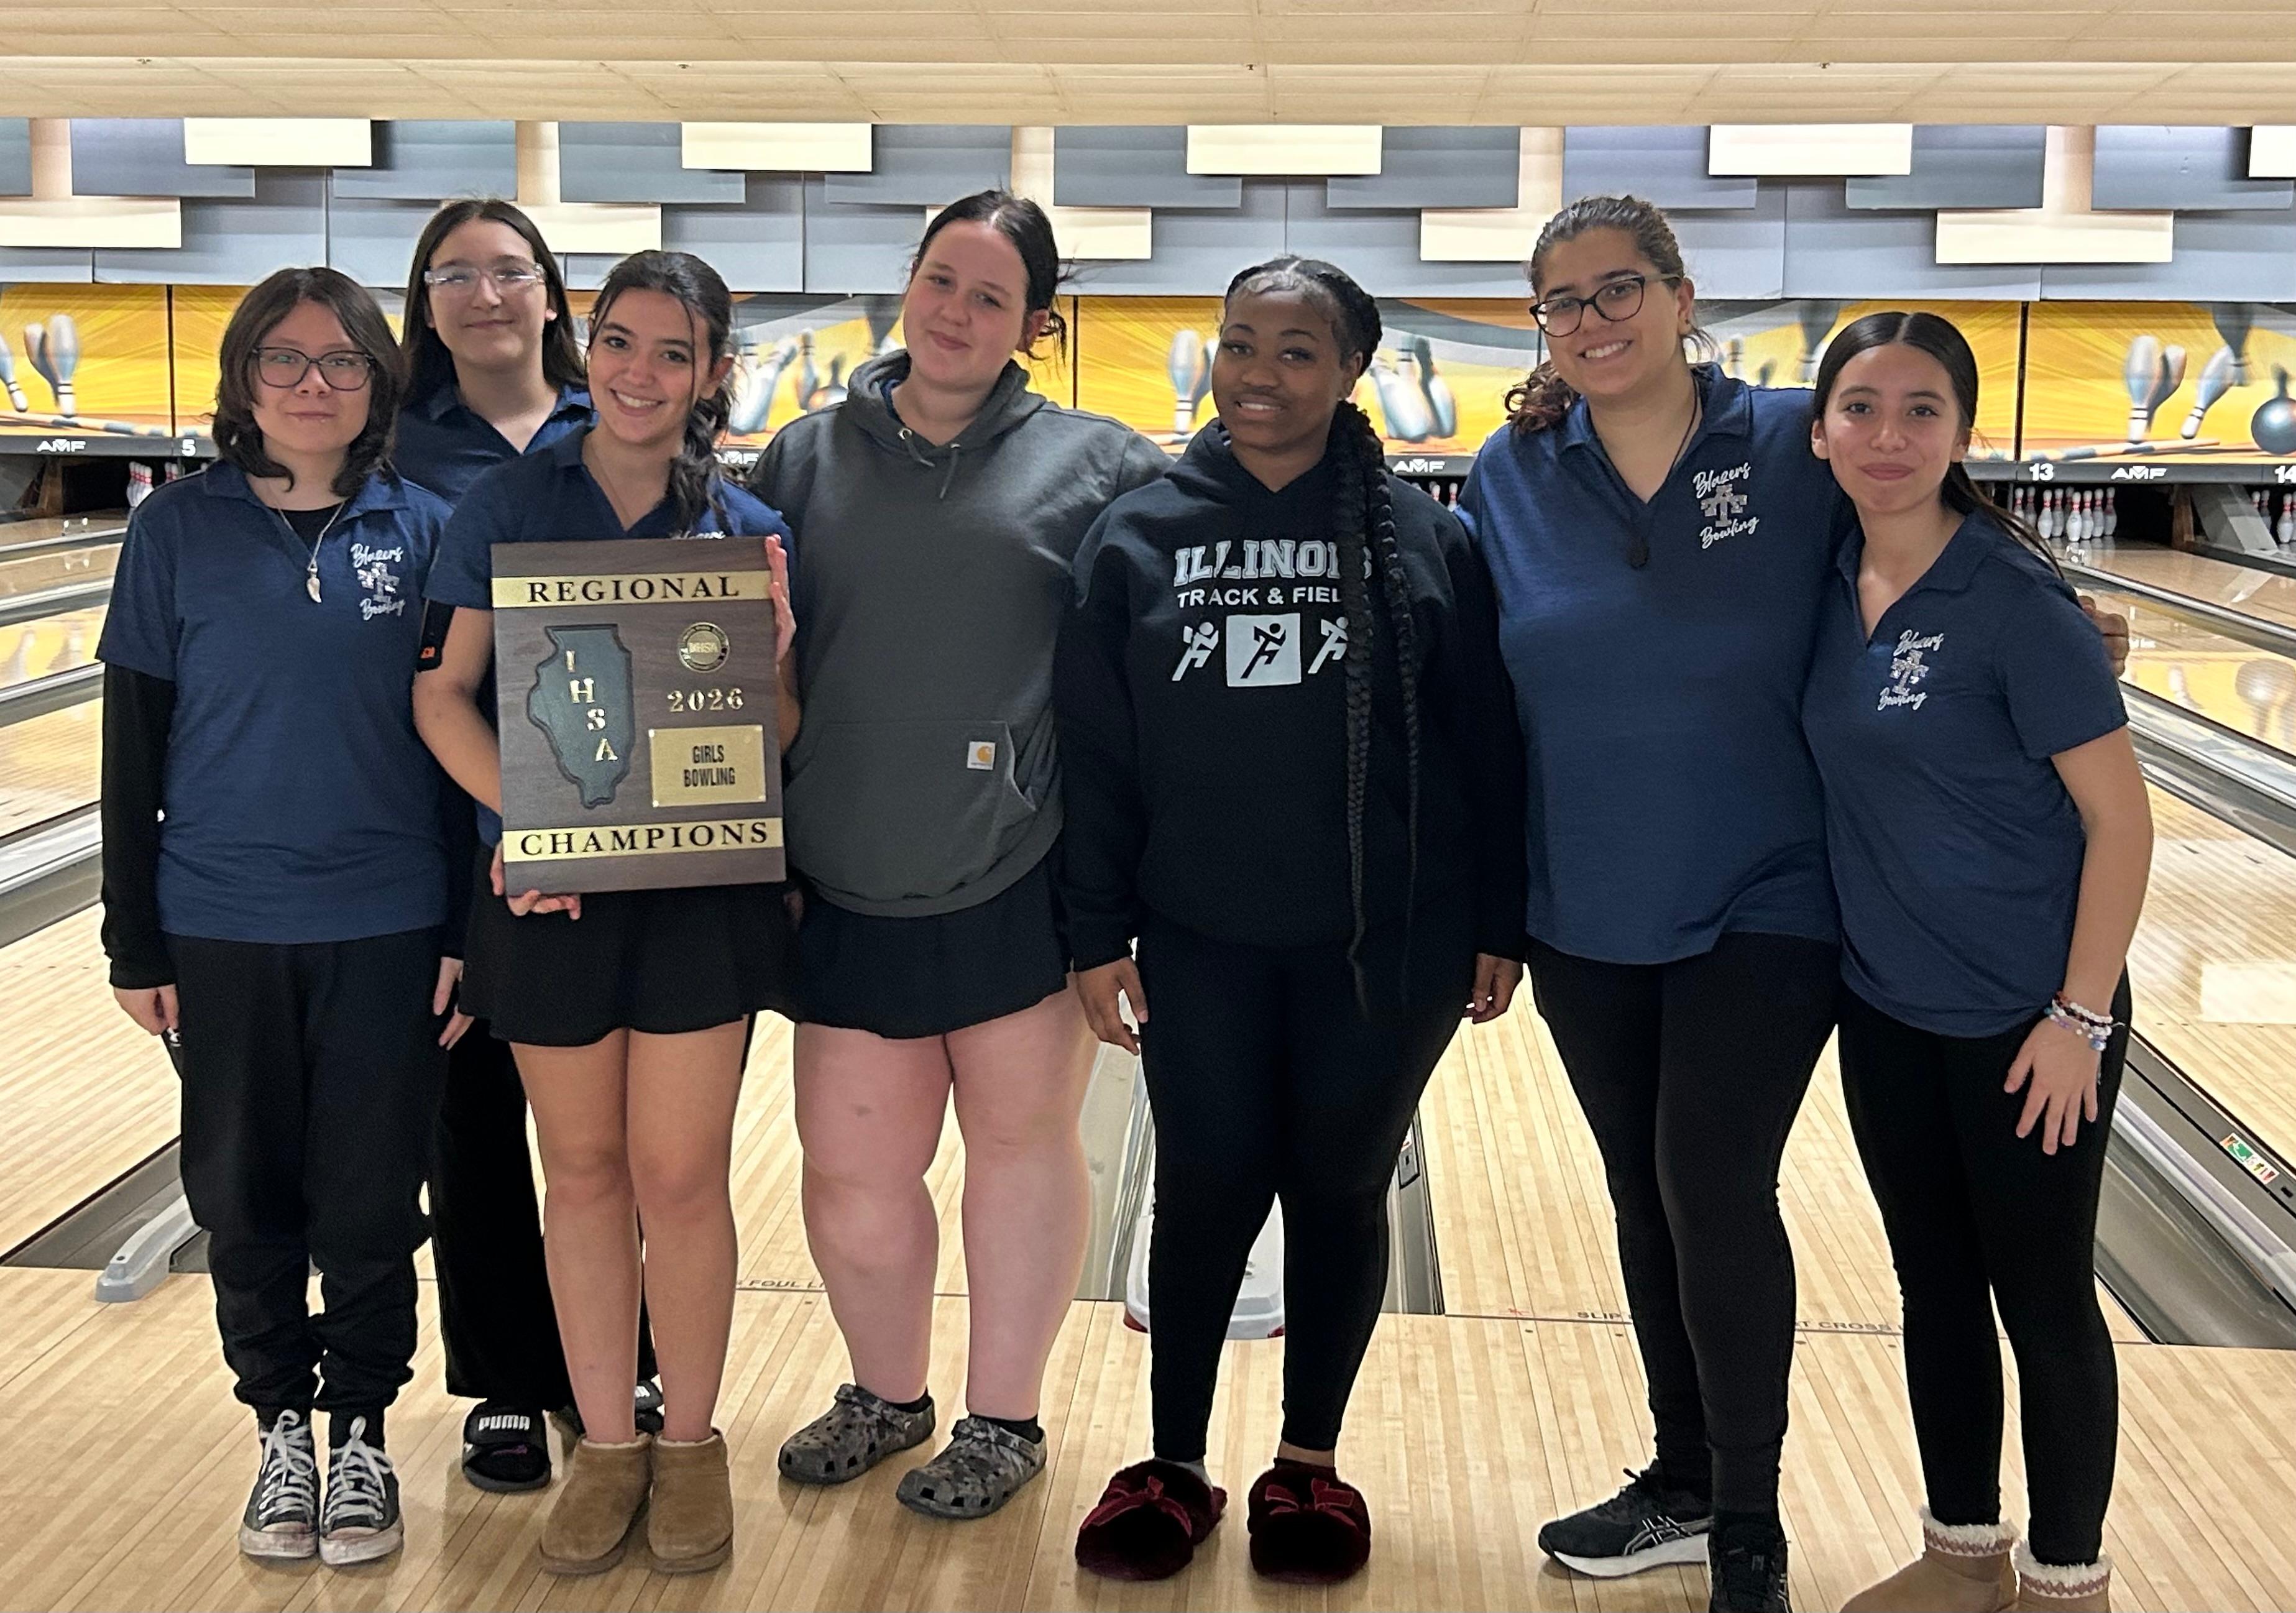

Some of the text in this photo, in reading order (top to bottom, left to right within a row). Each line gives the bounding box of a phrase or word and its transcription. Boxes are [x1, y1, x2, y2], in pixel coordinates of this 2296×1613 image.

[36, 438, 86, 453] AMF
[181, 439, 196, 457] 5
[1392, 458, 1445, 473] AMF
[2029, 462, 2054, 481] 13
[2111, 466, 2168, 480] AMF
[1692, 462, 1752, 499] Blazers
[1699, 517, 1760, 549] Bowling
[350, 543, 403, 568] Blazers
[1173, 539, 1372, 587] ILLINOI
[527, 576, 740, 603] REGIONAL
[1177, 586, 1343, 608] TRACK & FIEL
[667, 688, 744, 712] 2026
[692, 745, 725, 764] GIRLS
[684, 767, 735, 788] BOWLING
[520, 822, 768, 856] CHAMPIONS
[1819, 1321, 1891, 1330] CROSS
[478, 1415, 531, 1431] PUMA
